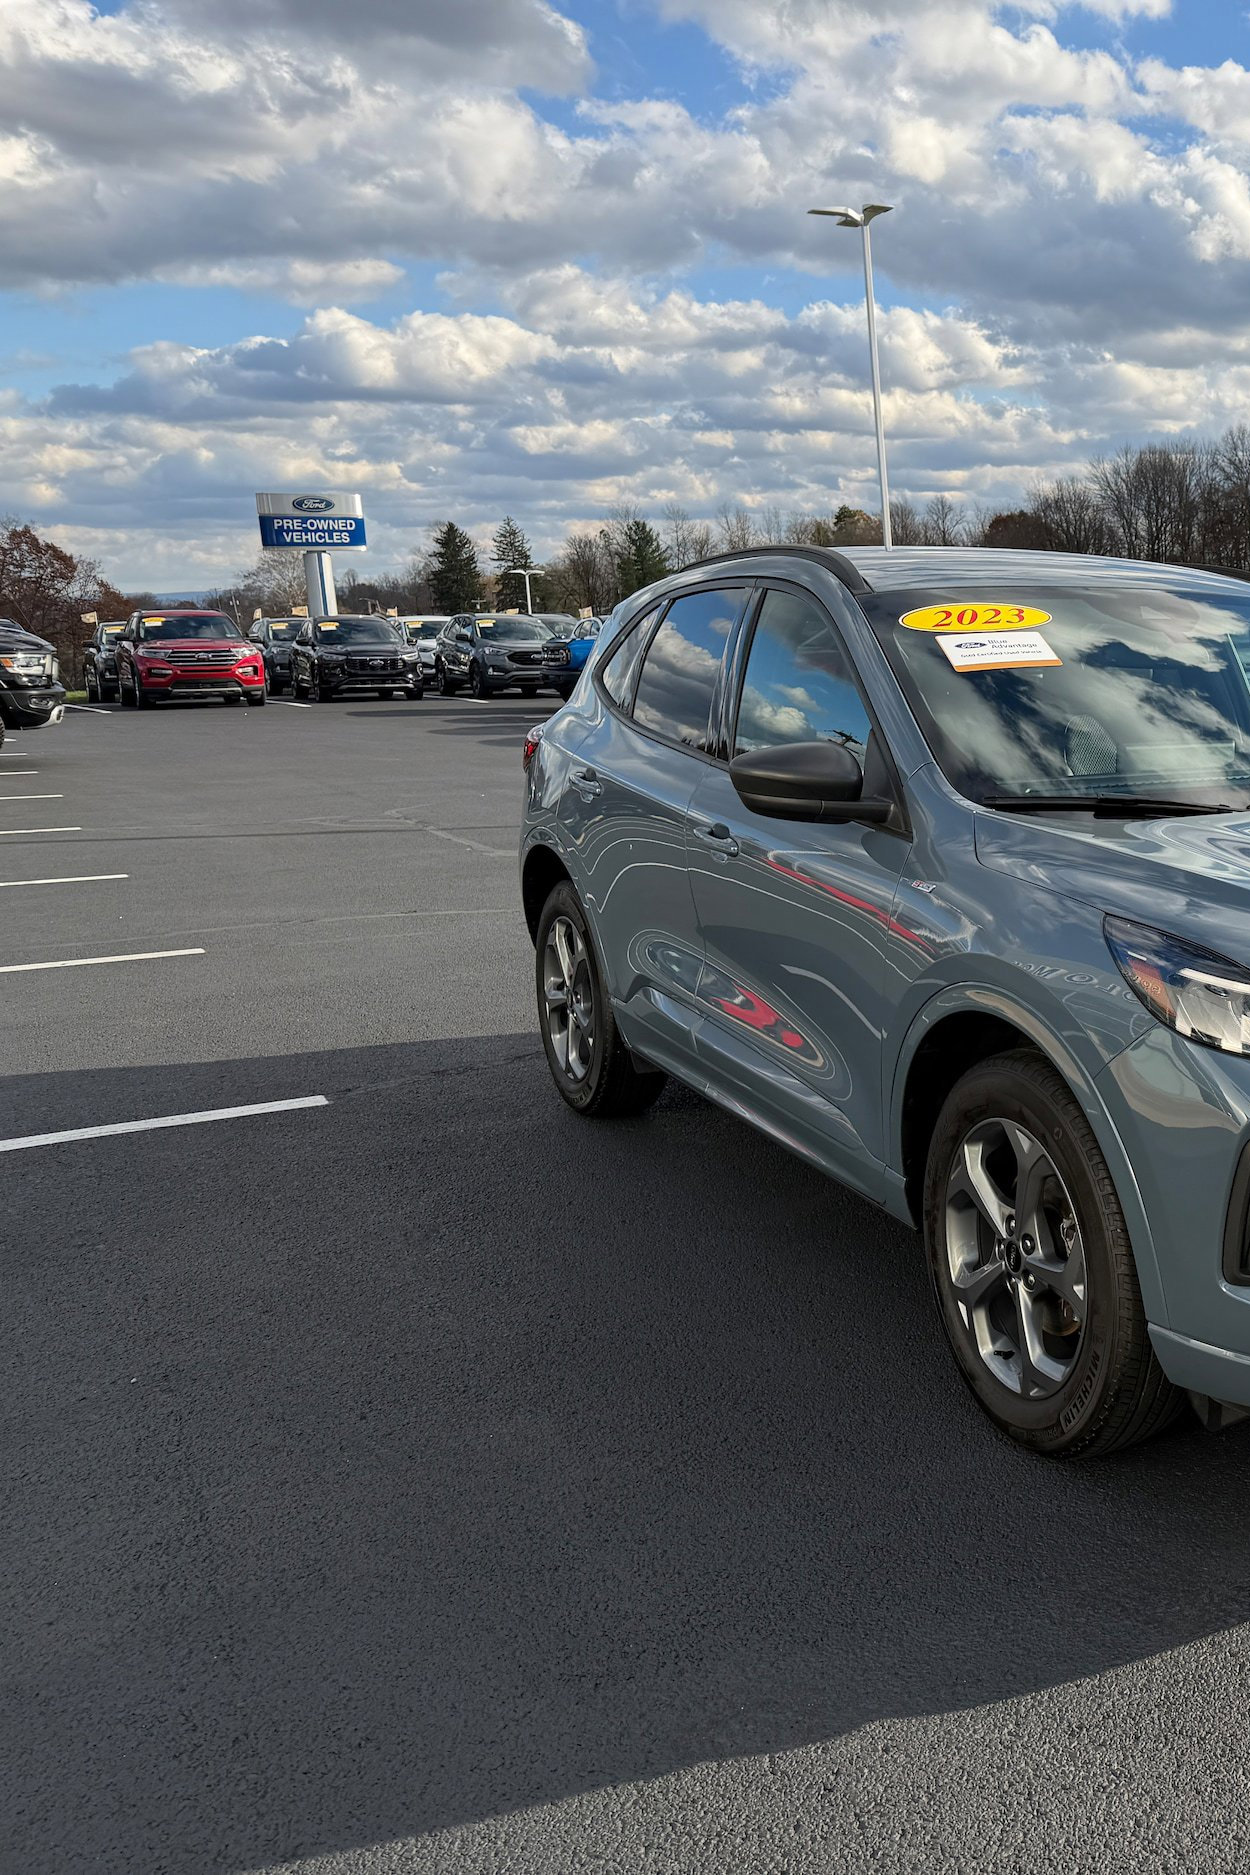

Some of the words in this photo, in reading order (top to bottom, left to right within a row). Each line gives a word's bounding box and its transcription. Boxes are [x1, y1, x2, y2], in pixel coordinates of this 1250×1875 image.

[302, 499, 326, 509] Ford
[273, 518, 356, 531] PRE-OWNED
[283, 531, 351, 544] VEHICLES
[932, 608, 1025, 628] 2023
[1064, 1350, 1100, 1428] MICHELIN
